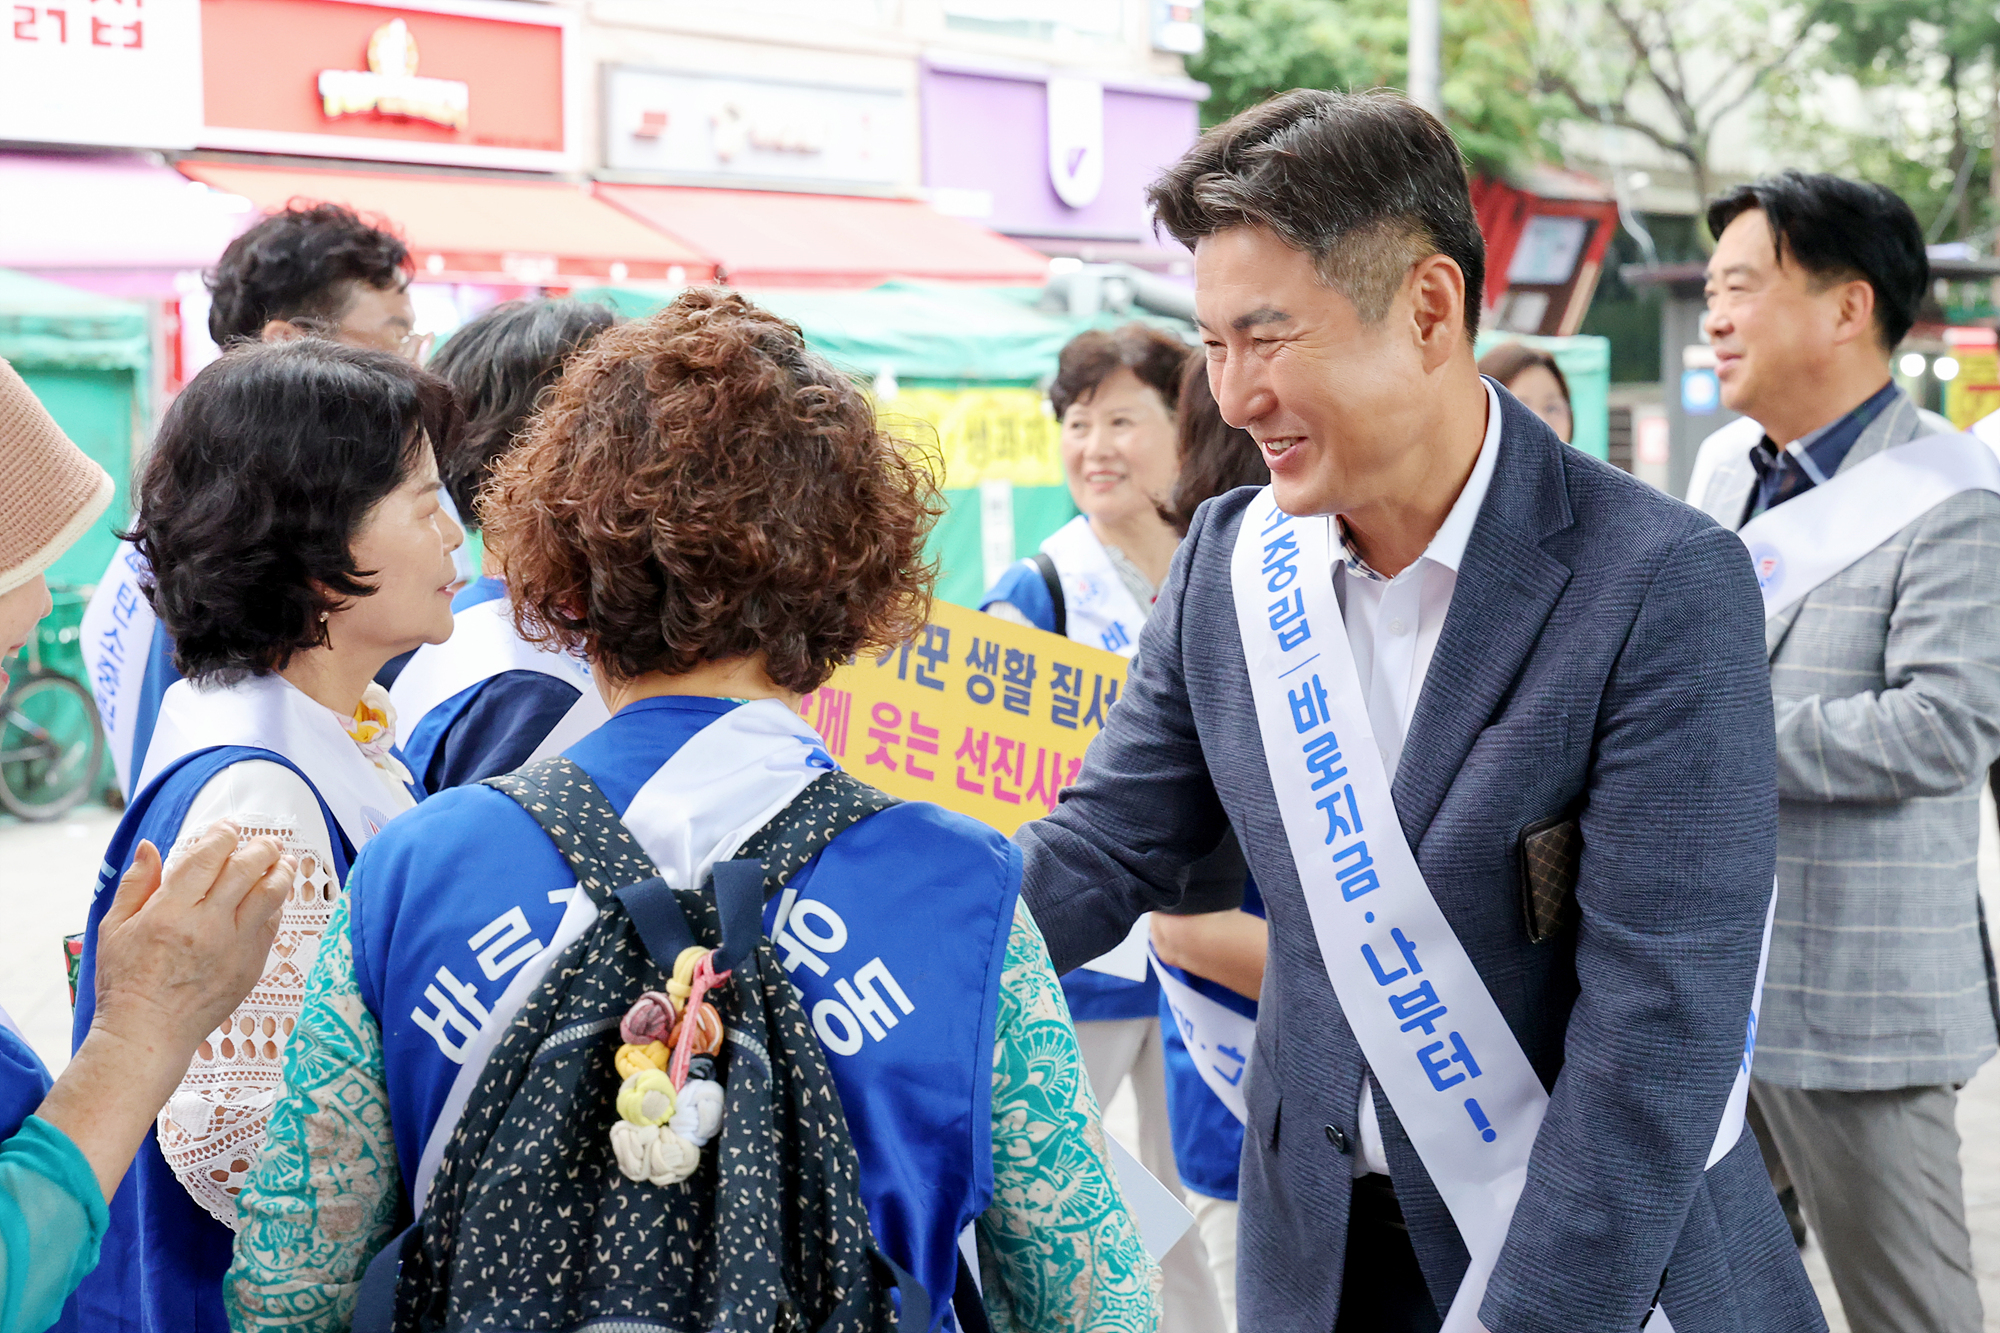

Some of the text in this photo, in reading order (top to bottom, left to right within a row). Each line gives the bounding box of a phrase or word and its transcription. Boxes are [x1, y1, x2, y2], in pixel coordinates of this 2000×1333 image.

[965, 636, 1037, 716] 생활
[1049, 661, 1119, 731] 질서
[865, 701, 941, 782] 웃는
